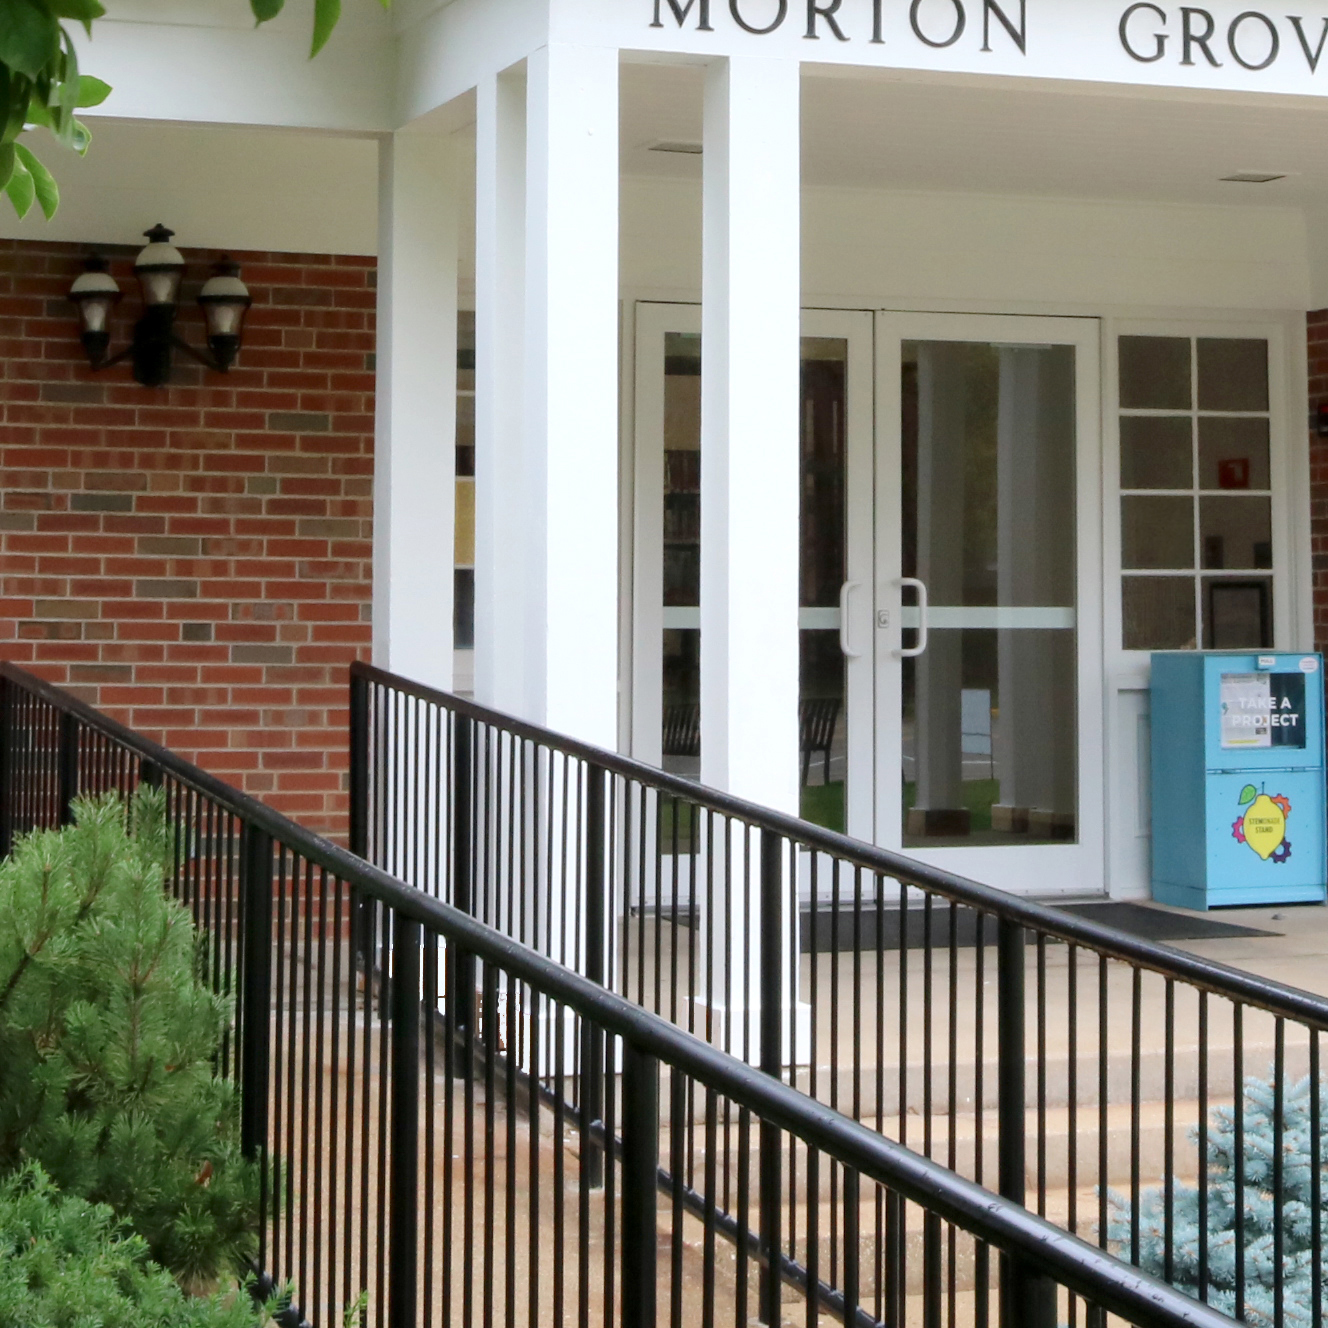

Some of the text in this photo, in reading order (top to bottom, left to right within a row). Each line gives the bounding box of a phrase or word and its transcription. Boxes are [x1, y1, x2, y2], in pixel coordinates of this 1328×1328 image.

[1239, 697, 1292, 709] TAKE A
[1232, 714, 1299, 726] PROJECT
